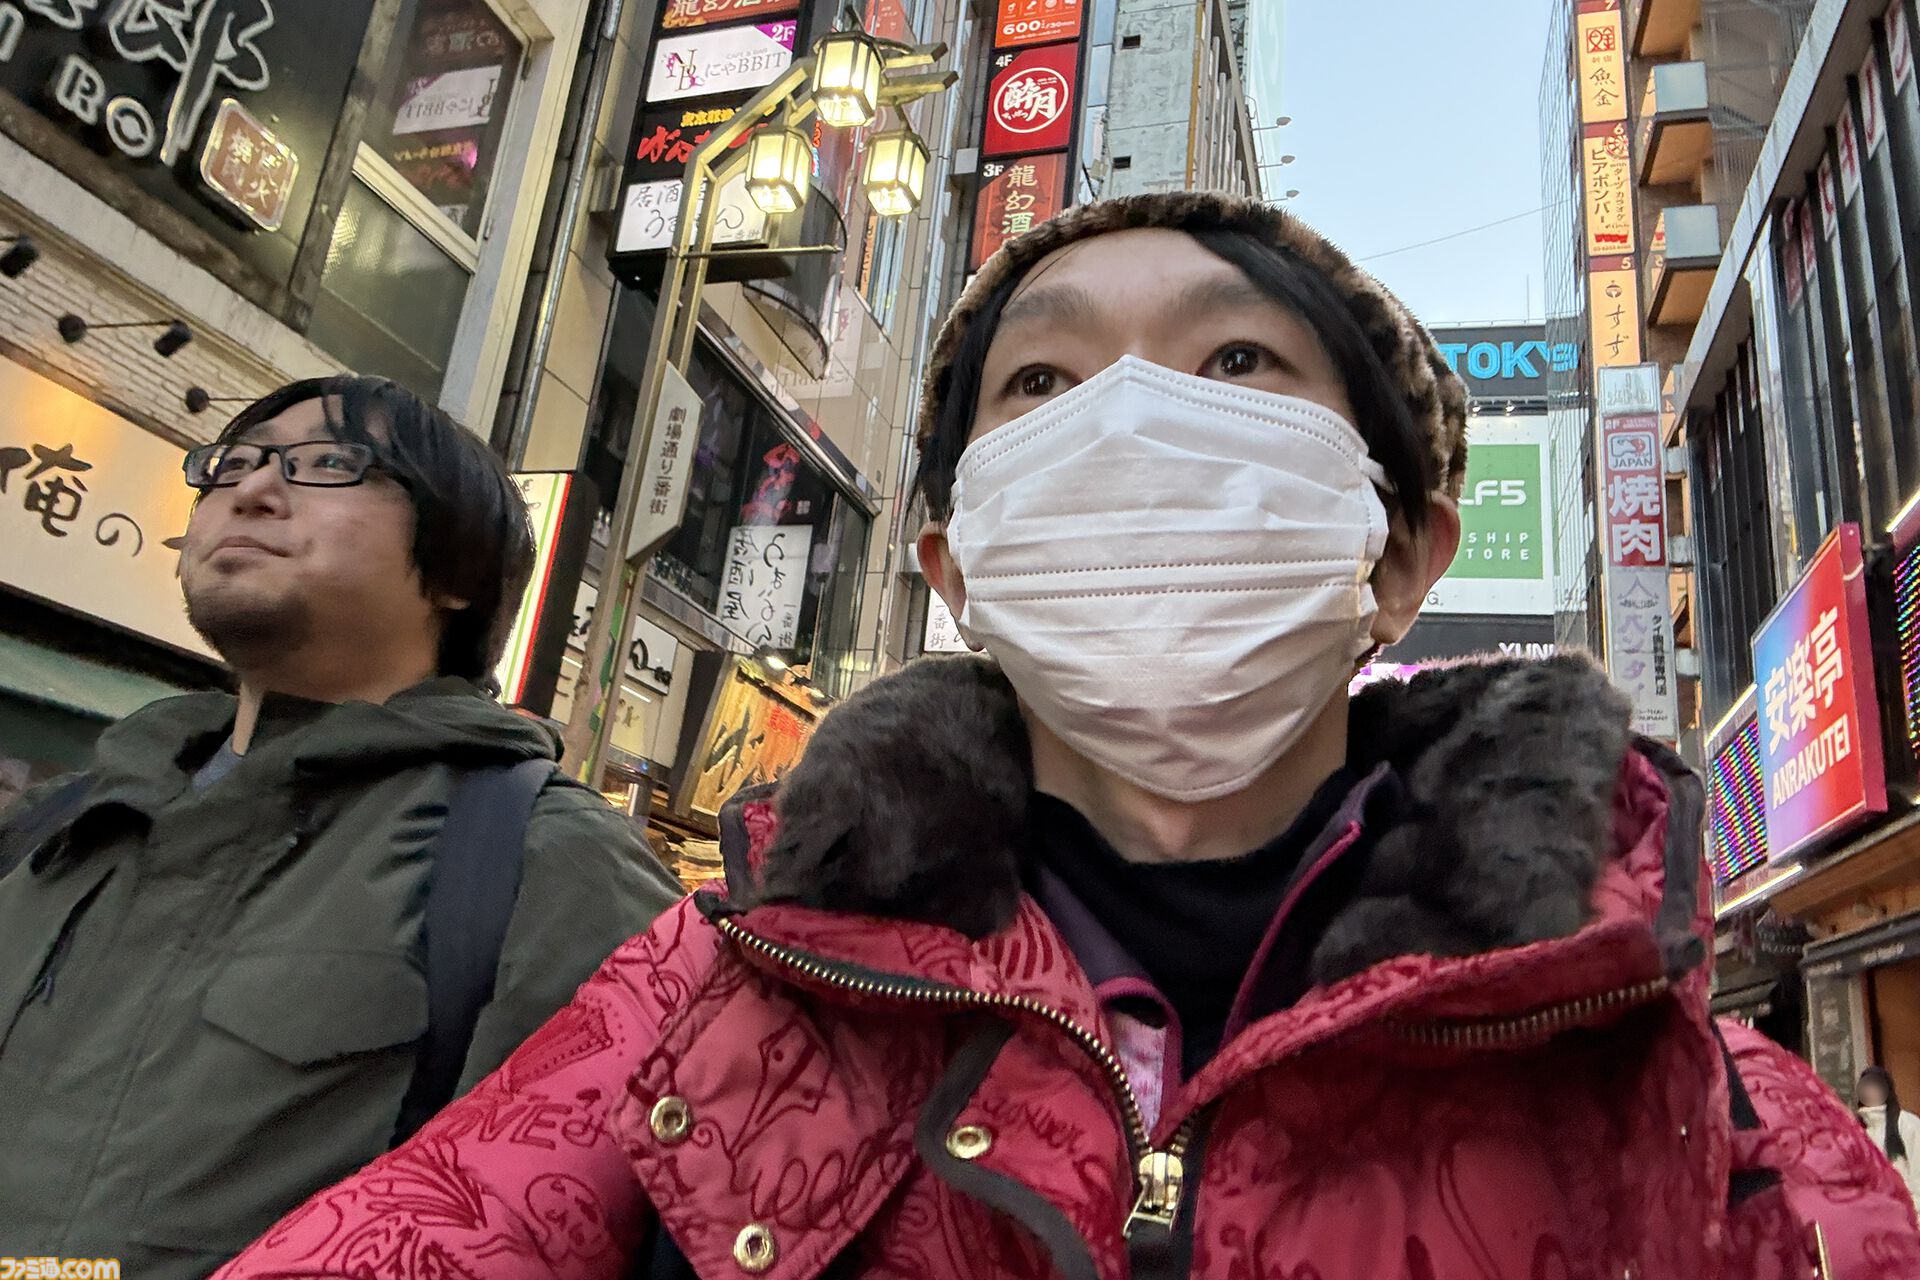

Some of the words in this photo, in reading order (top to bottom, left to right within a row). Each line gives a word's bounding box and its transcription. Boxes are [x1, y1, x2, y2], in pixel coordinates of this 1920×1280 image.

[772, 24, 796, 42] 2F
[995, 54, 1013, 68] 4F
[1613, 123, 1624, 135] 6
[983, 163, 1004, 177] 3F
[1621, 257, 1632, 270] 5
[1604, 303, 1629, 366] すず
[1438, 340, 1579, 380] TOKY
[649, 406, 687, 515] 劇場通り一番街
[1612, 457, 1652, 468] JAPAN
[1609, 474, 1661, 562] 焼肉
[929, 604, 948, 649] 一番街
[1764, 606, 1844, 756] 安楽亭
[1772, 714, 1851, 810] ANRAKUTEI
